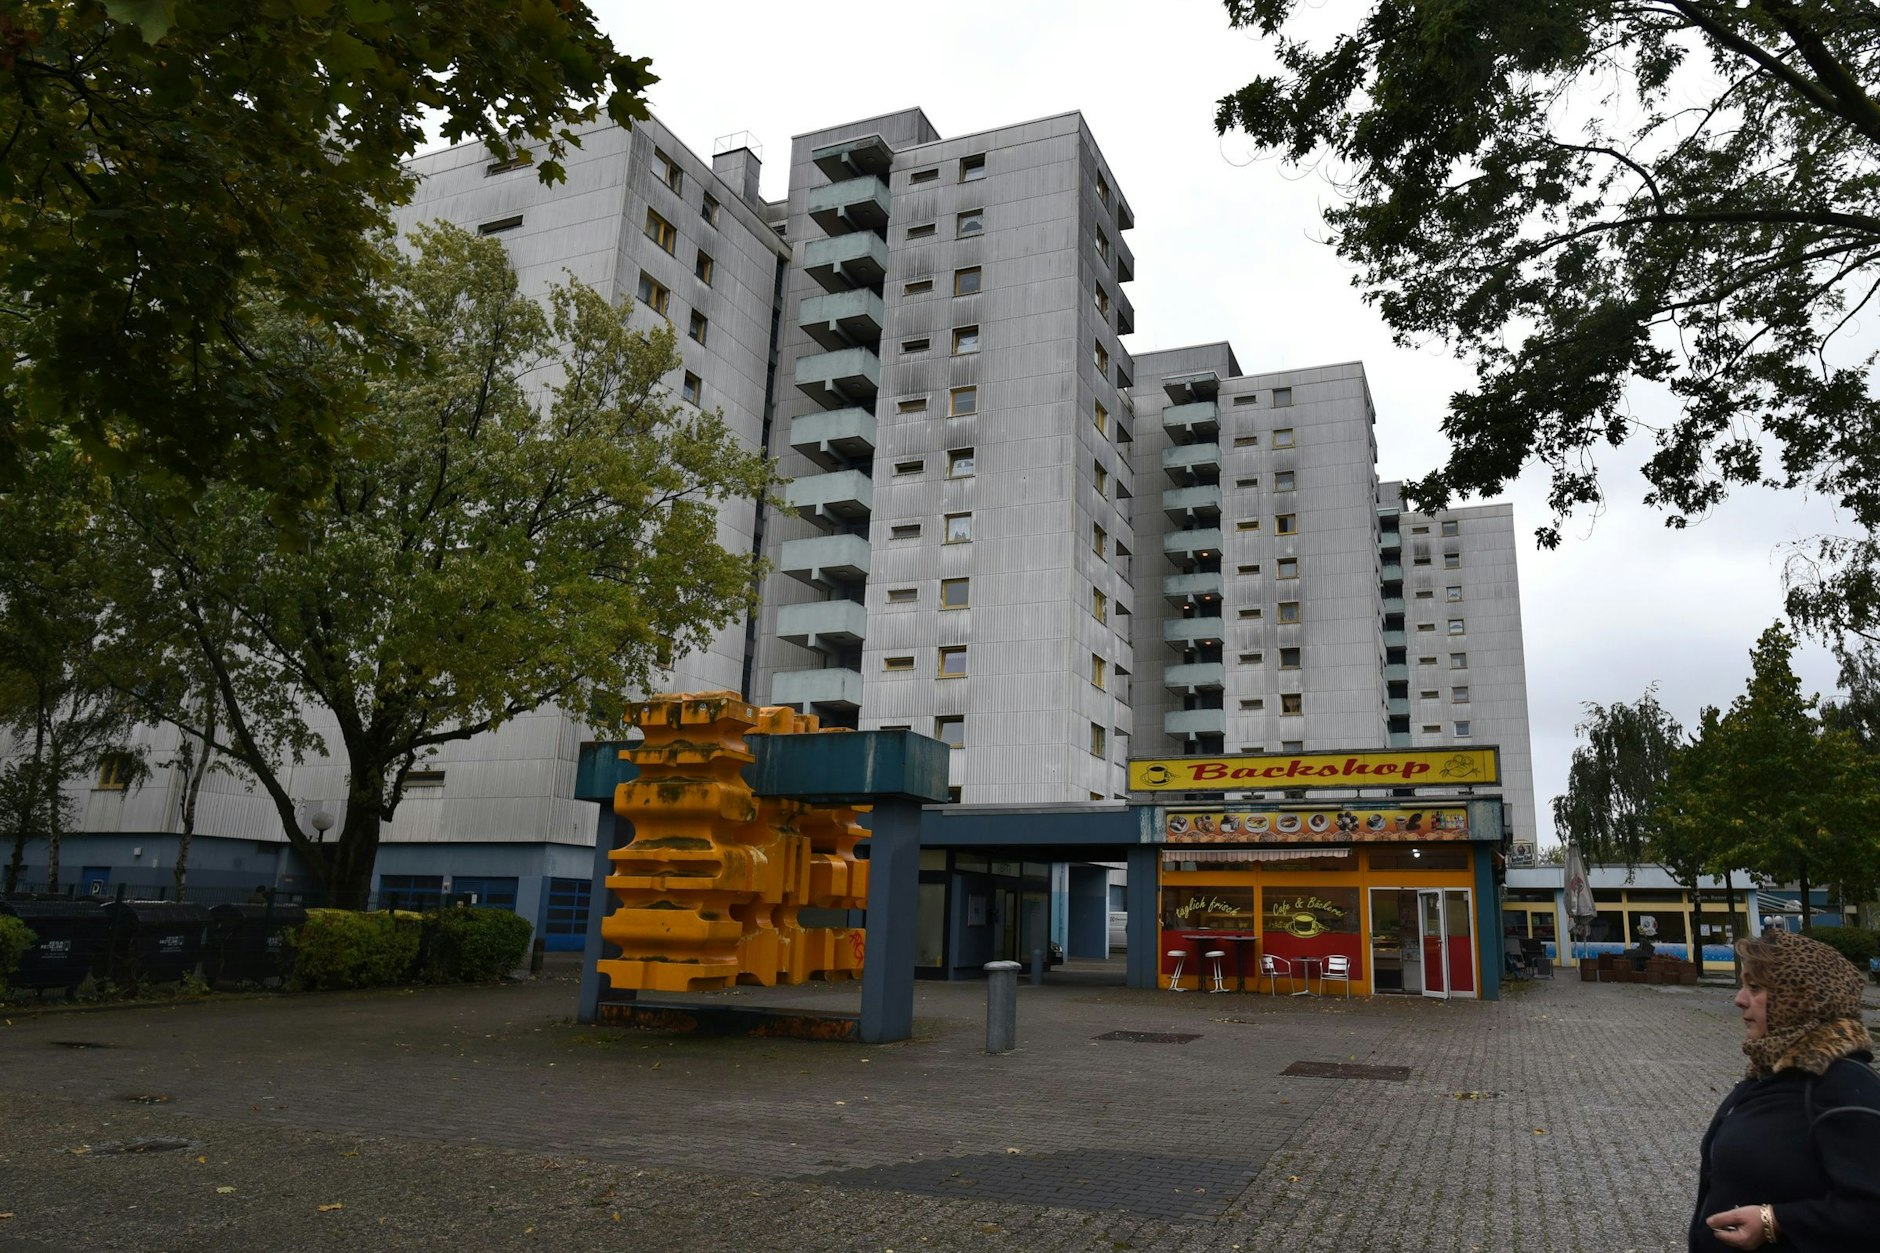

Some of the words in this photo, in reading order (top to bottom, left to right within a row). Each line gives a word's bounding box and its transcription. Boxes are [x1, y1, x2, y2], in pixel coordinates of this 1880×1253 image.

[1187, 758, 1430, 781] Backshop
[1176, 896, 1206, 919] täglich
[1207, 896, 1240, 916] frisch
[1295, 897, 1304, 909] &
[1307, 896, 1348, 917] Bäckerei
